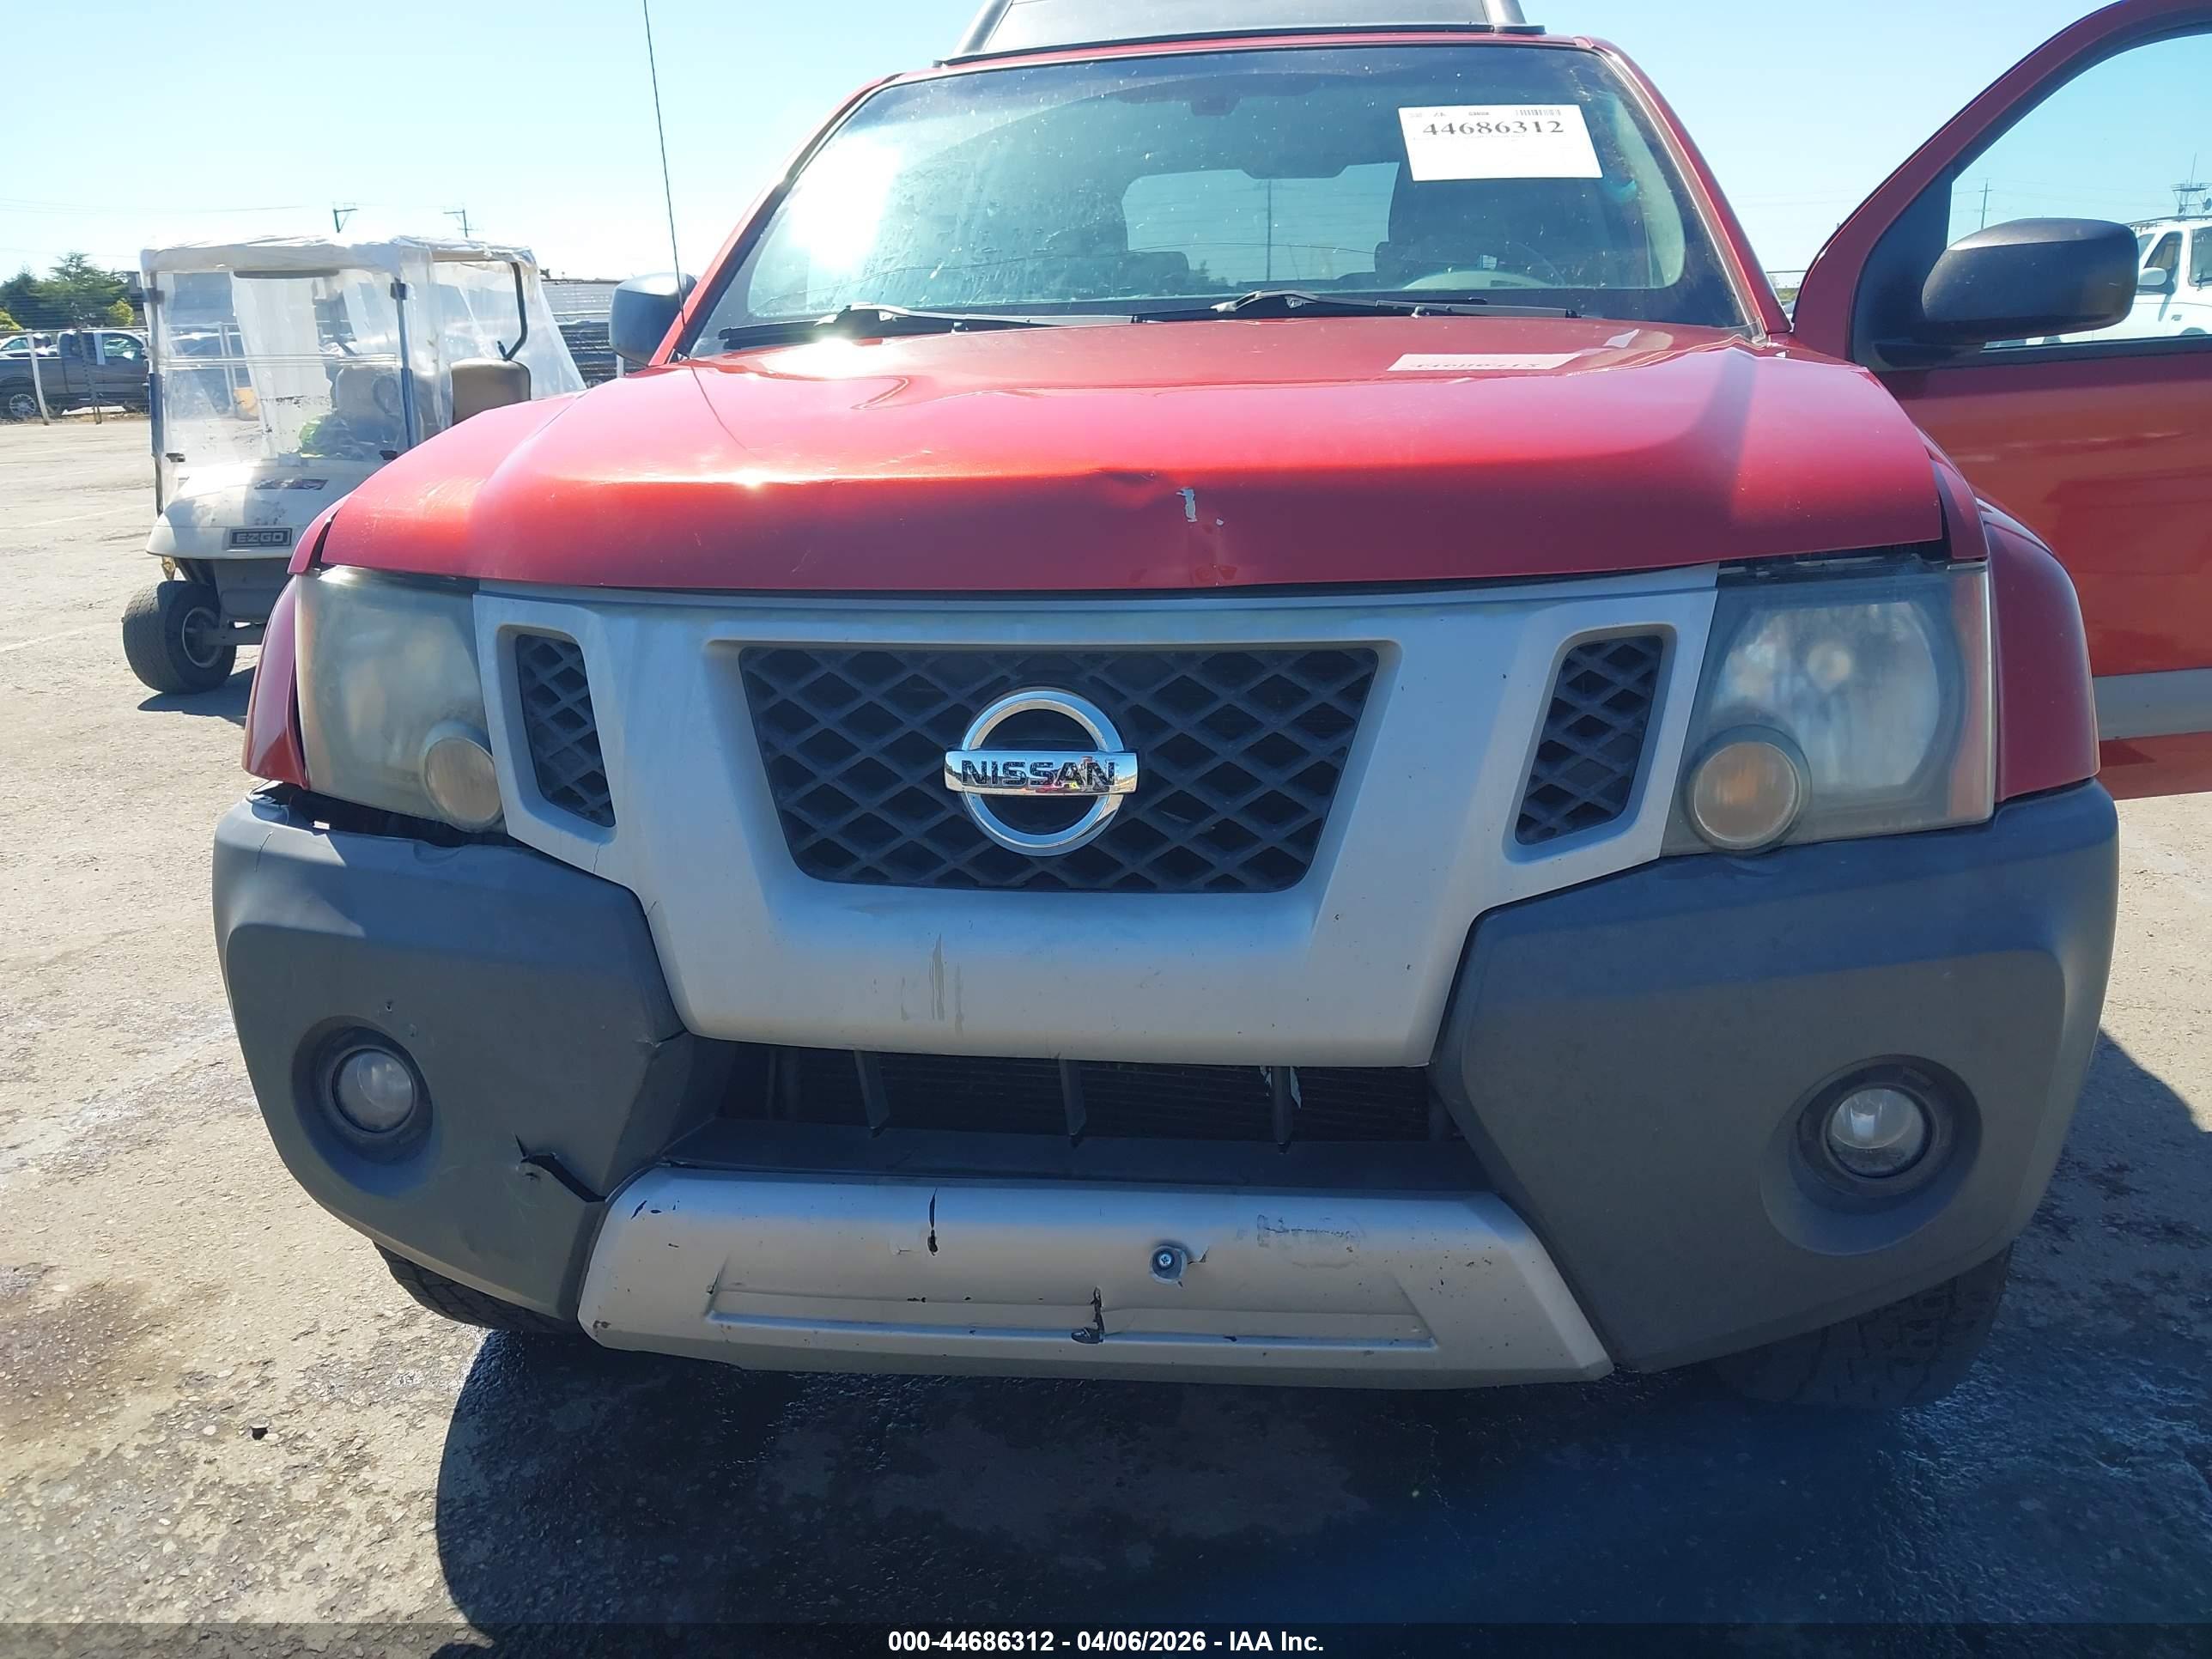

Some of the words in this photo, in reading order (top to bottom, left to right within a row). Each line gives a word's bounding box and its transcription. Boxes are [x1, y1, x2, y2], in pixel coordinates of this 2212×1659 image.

[1423, 120, 1565, 136] 44686312
[236, 532, 284, 543] EZGO
[961, 759, 1115, 787] NISSAN
